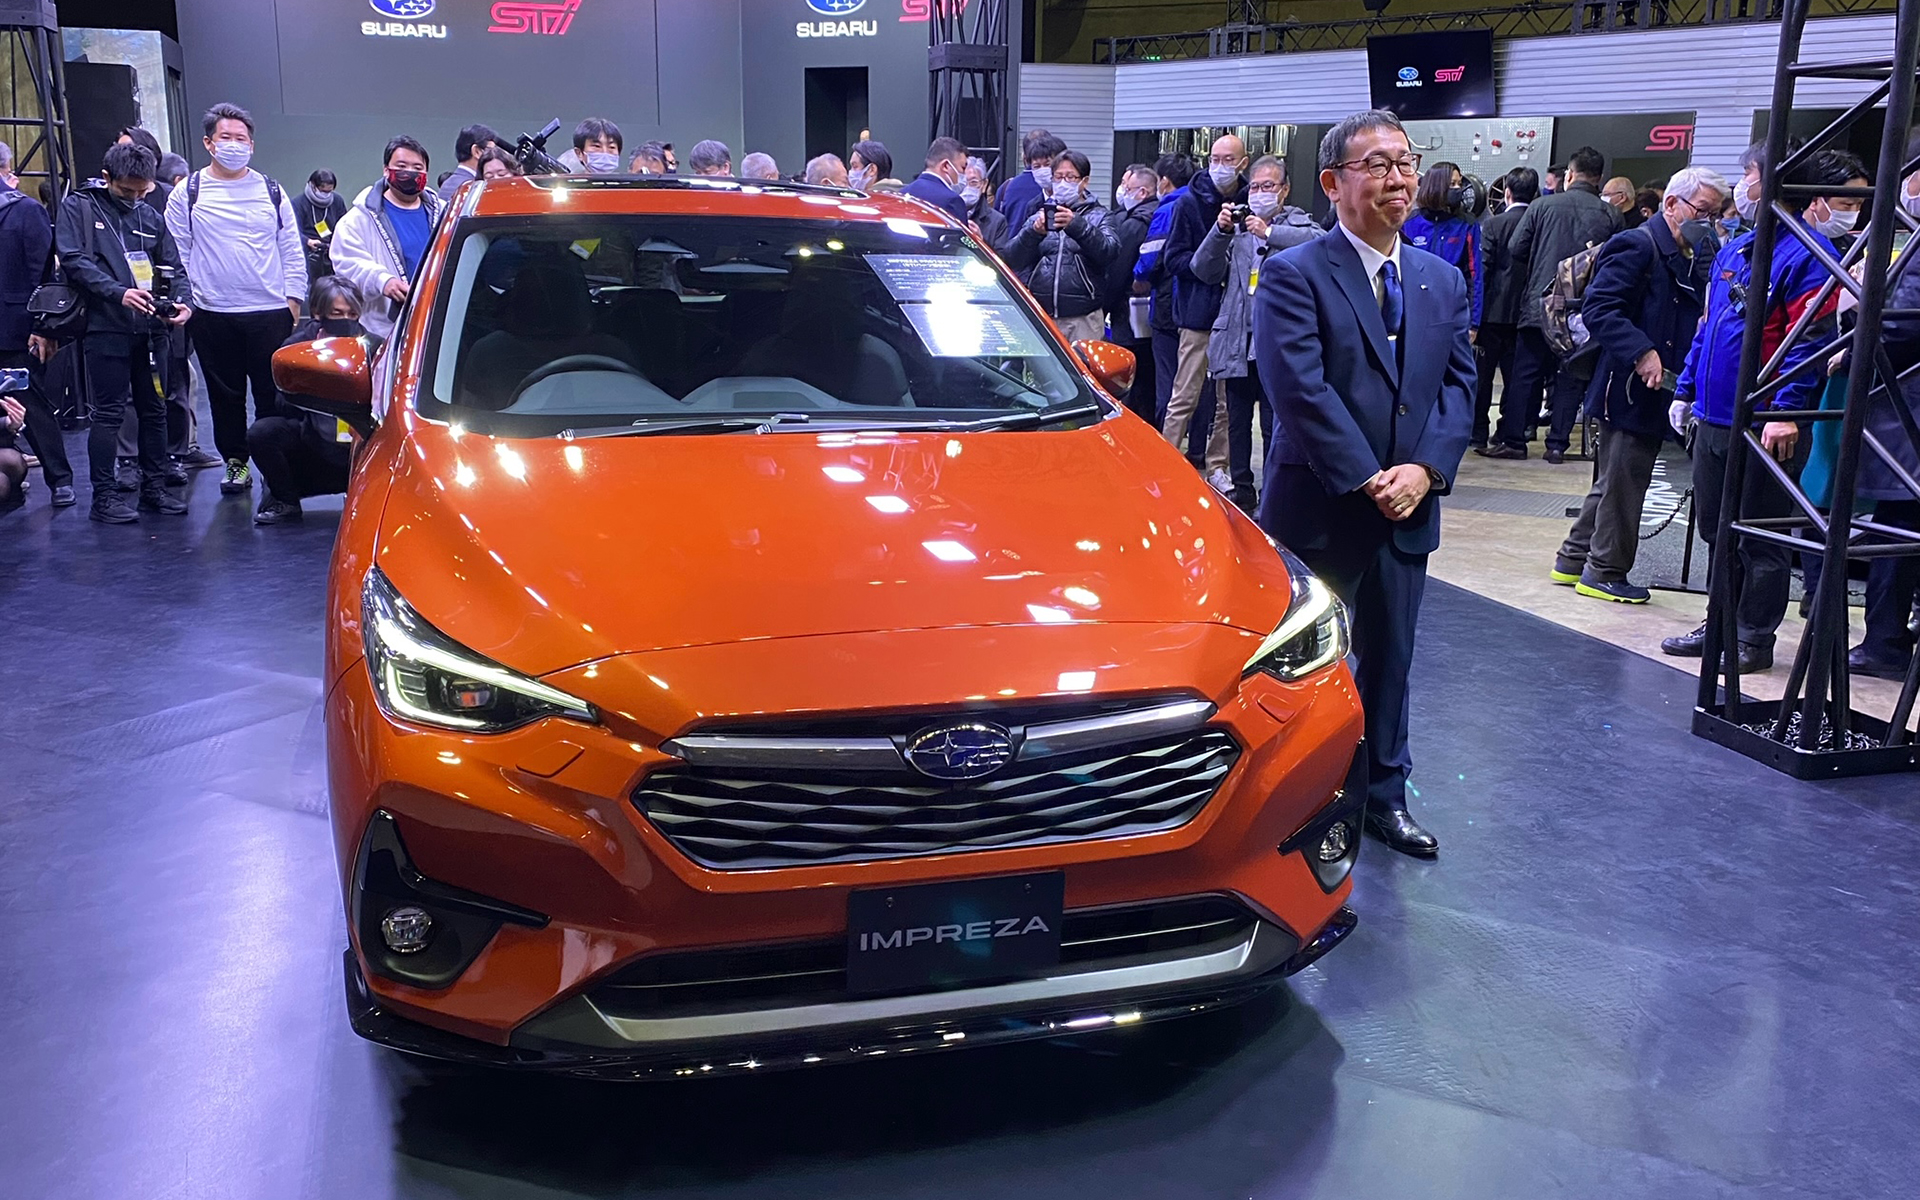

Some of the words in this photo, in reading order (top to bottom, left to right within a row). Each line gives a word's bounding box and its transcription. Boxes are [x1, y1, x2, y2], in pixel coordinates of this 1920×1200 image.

[361, 21, 447, 38] SUBARU
[796, 20, 877, 37] SUBARU
[860, 916, 1049, 951] IMPREZA
